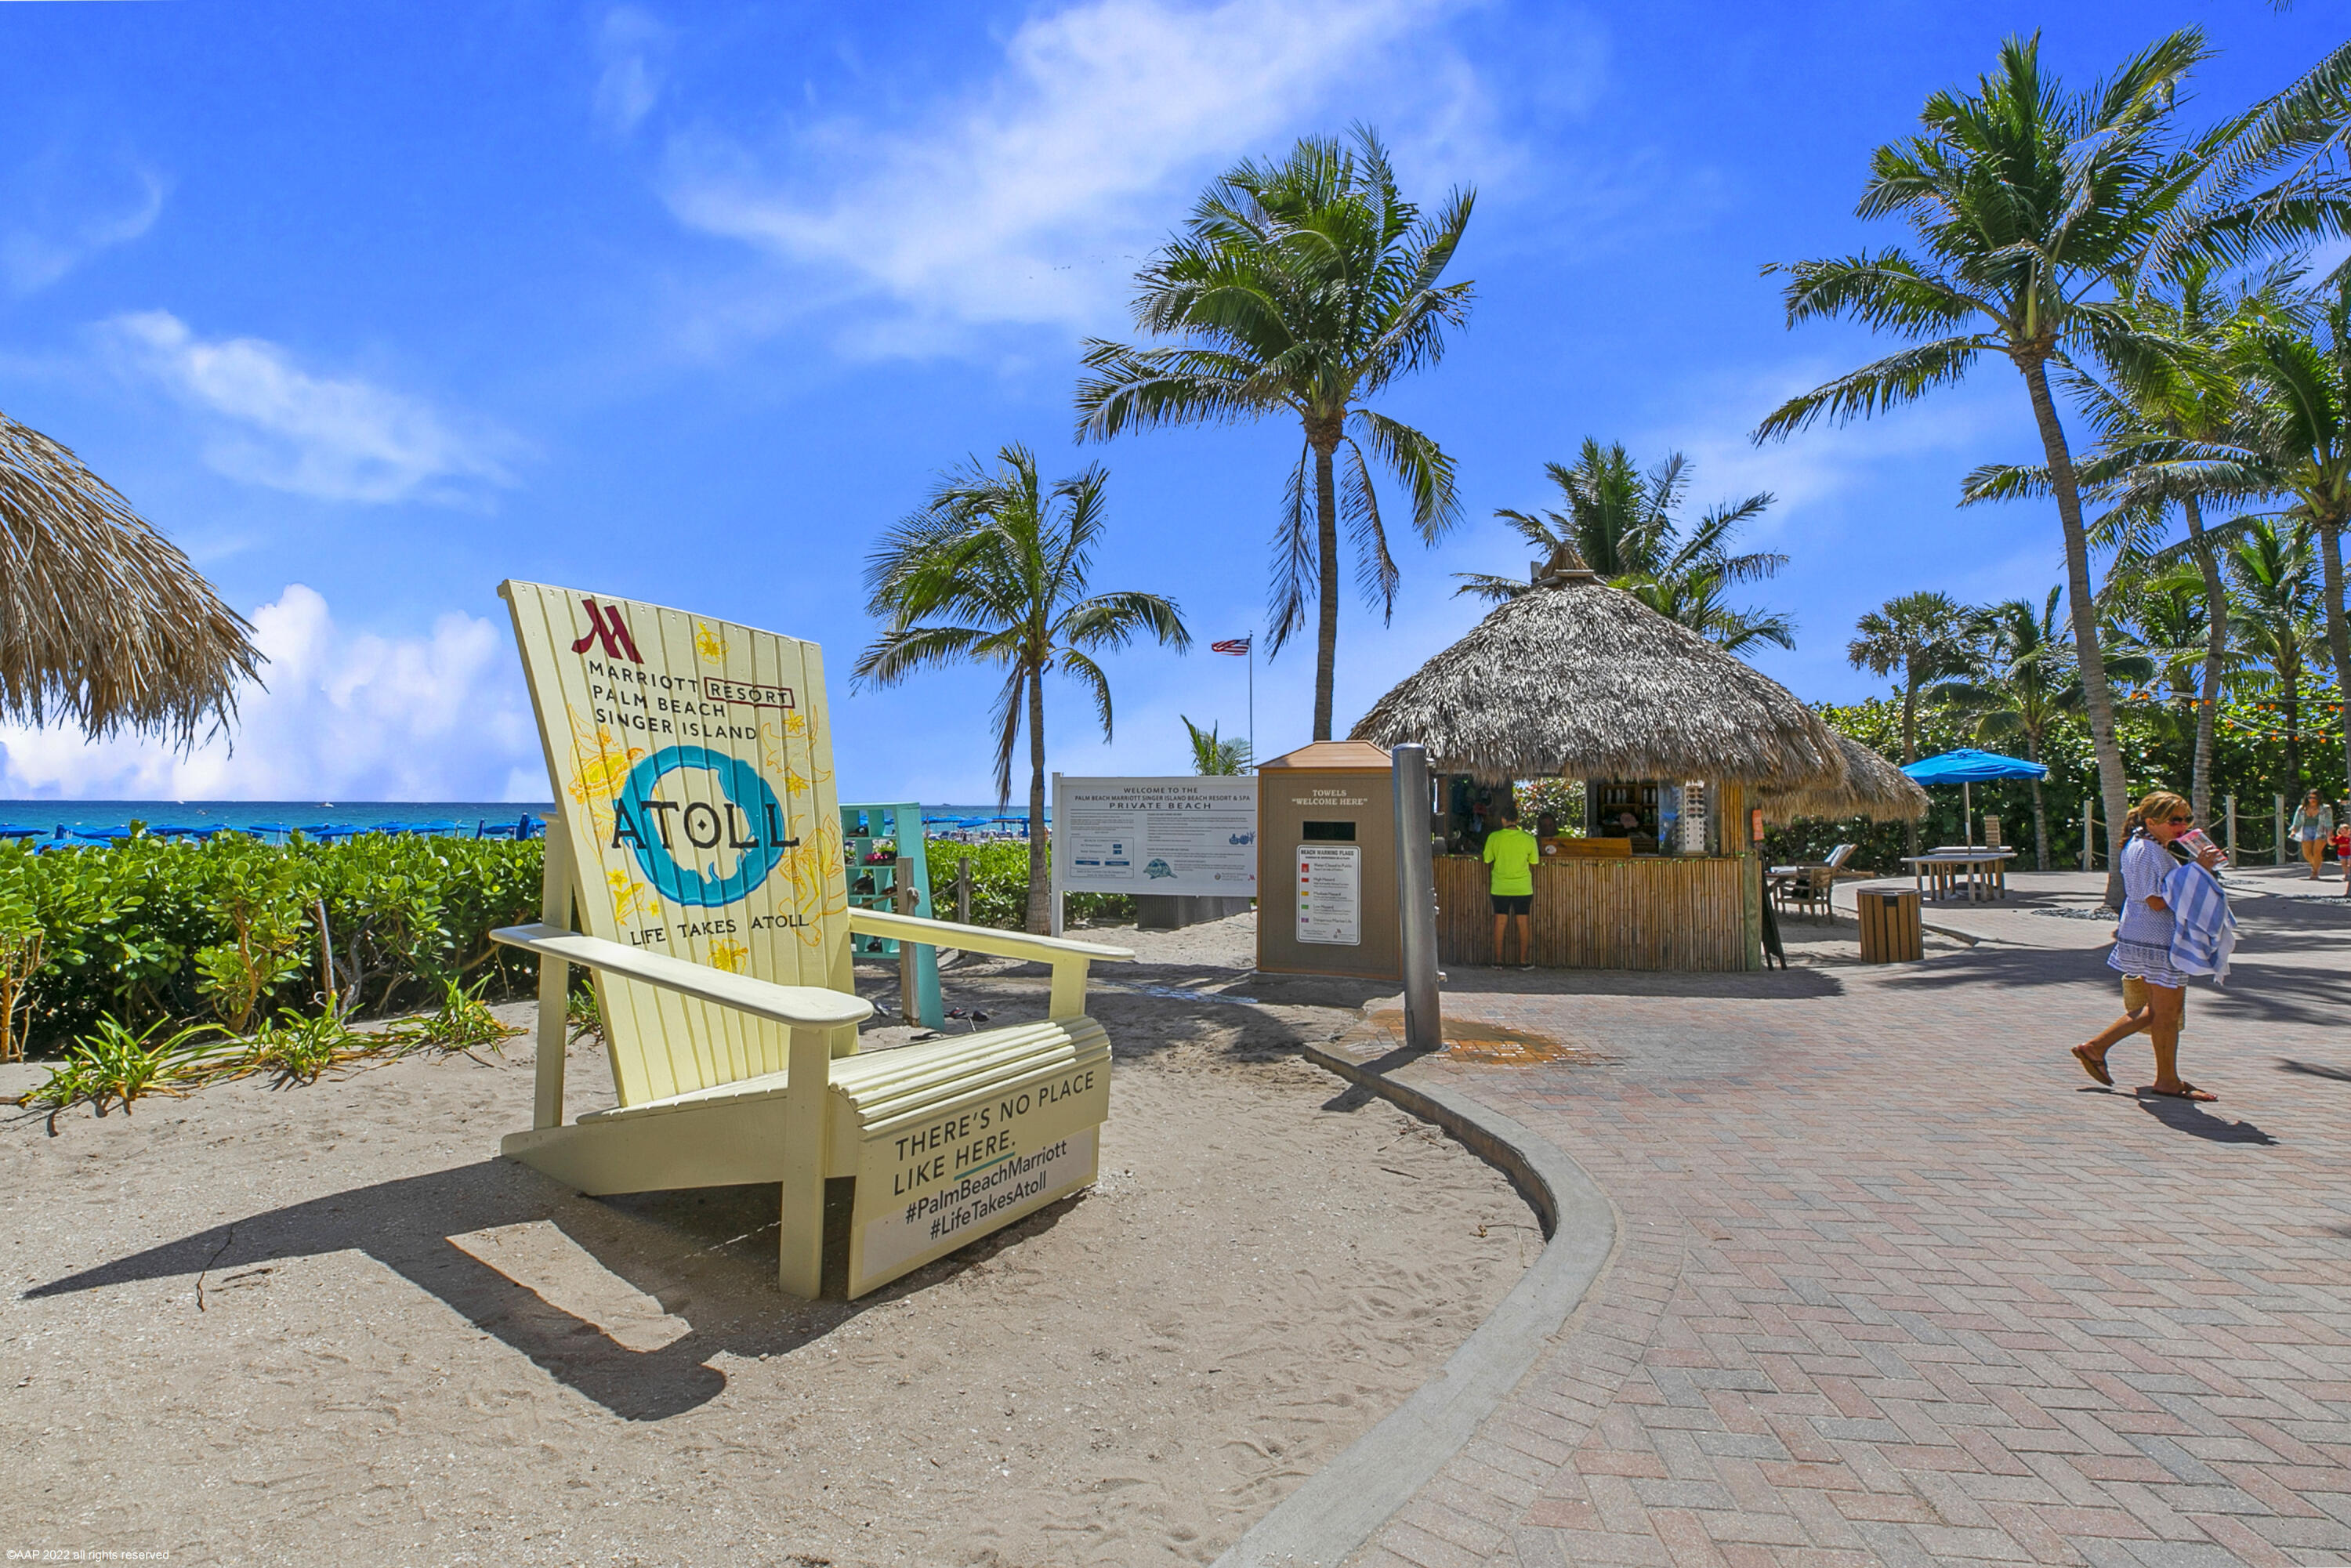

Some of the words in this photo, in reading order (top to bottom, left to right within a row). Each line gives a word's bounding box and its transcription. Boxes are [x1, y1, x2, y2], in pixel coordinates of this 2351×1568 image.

[589, 660, 697, 693] MARRIOTT
[710, 683, 789, 704] RESORT
[592, 685, 647, 708] PALM
[658, 698, 725, 718] BEACH
[596, 708, 672, 733] SINGER
[683, 723, 757, 740] ISLAND
[612, 798, 800, 849] ATOLL
[630, 928, 666, 945] LIFE
[677, 919, 737, 938] TAKES
[751, 914, 810, 929] ATOLL
[895, 1106, 991, 1161] THERE'S
[999, 1094, 1031, 1122] NO
[1038, 1070, 1094, 1107] PLACE
[893, 1155, 945, 1196] LIKE
[955, 1129, 1016, 1170] HERE.
[904, 1140, 1067, 1225] #PalmBeachMarriott
[930, 1171, 1047, 1240] #LifeTakesAtoll
